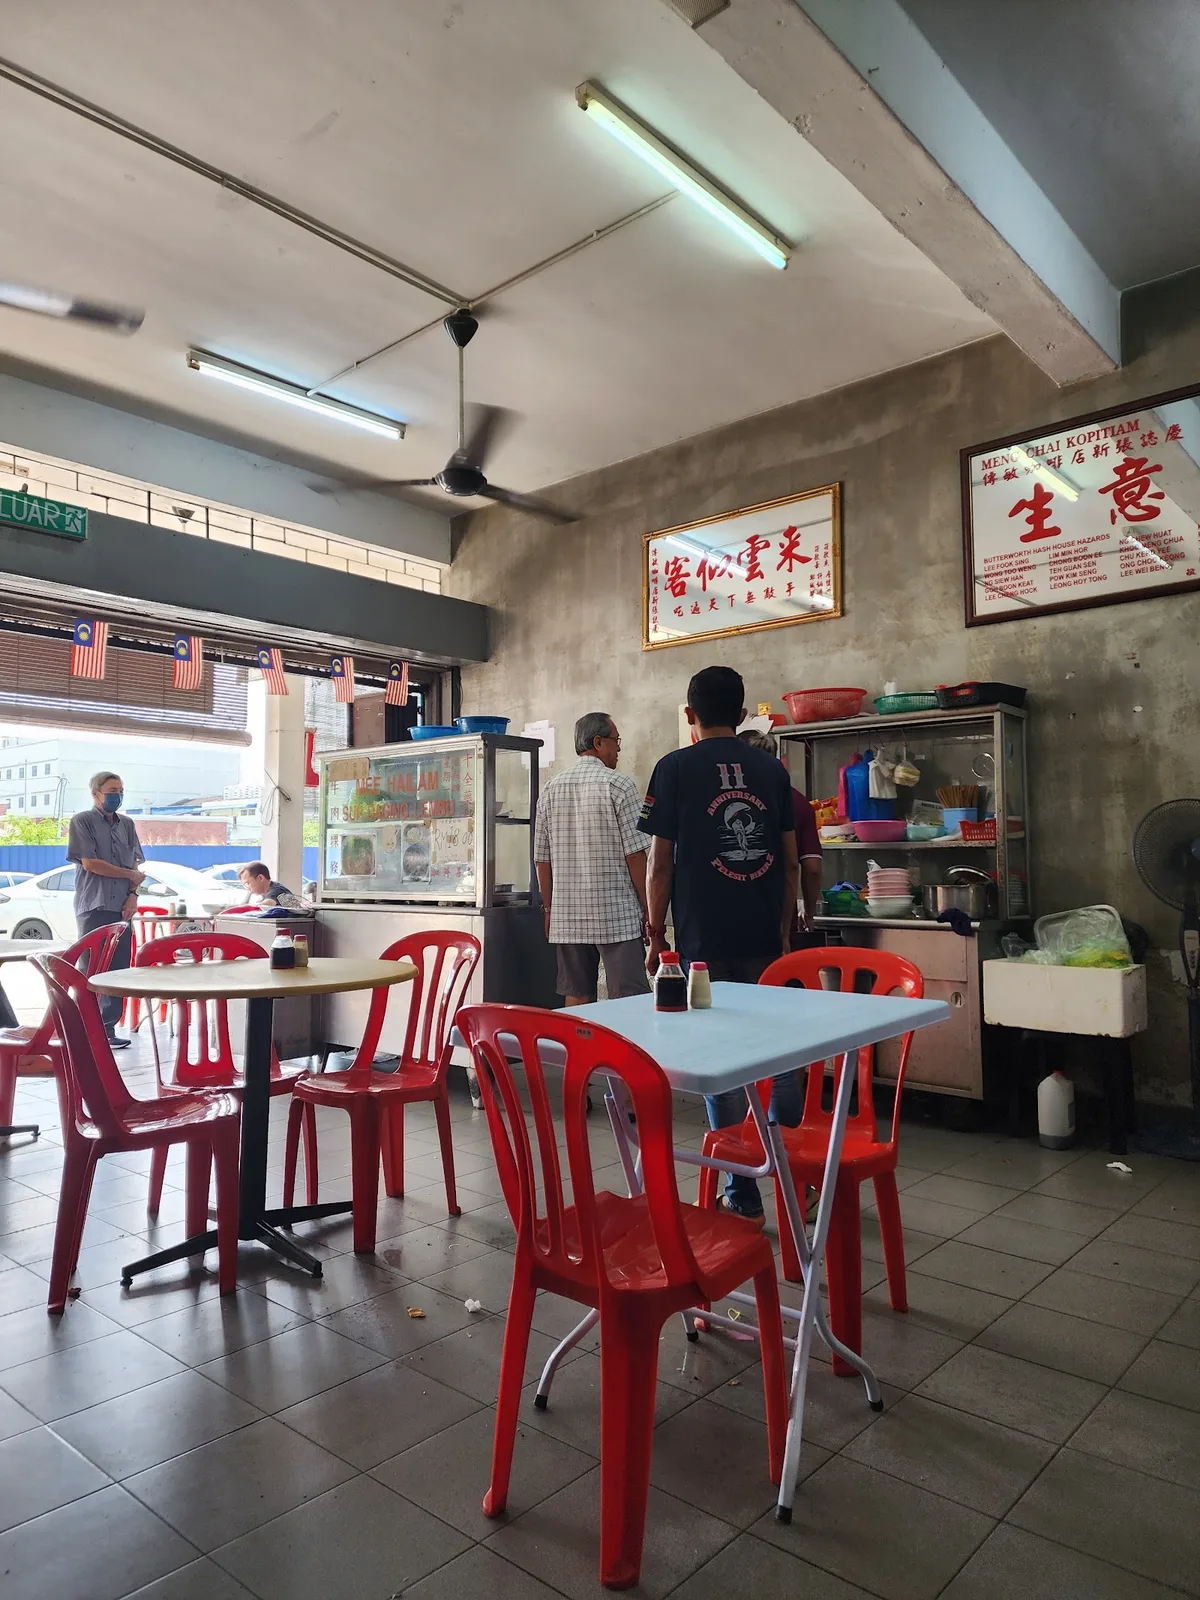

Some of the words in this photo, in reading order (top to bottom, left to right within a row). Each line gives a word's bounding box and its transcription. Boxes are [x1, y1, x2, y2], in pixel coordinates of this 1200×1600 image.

[981, 449, 1020, 471] MENG
[1025, 439, 1060, 459] CHAI
[1066, 418, 1140, 449] KOPITIAM
[1008, 456, 1165, 543] 生意
[1152, 530, 1172, 538] HUAT
[1164, 536, 1185, 544] CHUA
[983, 549, 1032, 564] BUTTERWORTH
[1032, 545, 1051, 555] HASH
[1052, 540, 1076, 550] HOUSE
[1077, 533, 1111, 545] HAZARDS
[1060, 550, 1073, 558] MIN
[1074, 546, 1088, 554] HOR
[996, 560, 1014, 569] FOOK
[1048, 558, 1072, 566] CHONG
[1073, 552, 1092, 562] BOON
[1120, 554, 1134, 562] CHU
[984, 571, 1003, 579] WONG
[1018, 564, 1037, 572] WENG
[1062, 564, 1082, 572] GUAN
[1120, 562, 1136, 570] ONG
[1135, 566, 1148, 574] WEI
[994, 576, 1010, 584] SIEW
[1049, 574, 1064, 582] POW
[1066, 572, 1078, 580] KIM
[1078, 568, 1098, 576] SENG
[1050, 581, 1072, 590] LEONG
[1088, 574, 1108, 582] TONG
[1018, 580, 1034, 588] KEAT
[1020, 586, 1038, 595] HOCK
[356, 775, 381, 796] MEE
[386, 770, 439, 793] HAILAM
[716, 763, 747, 790] 11
[414, 799, 456, 818] LEMBU
[706, 790, 768, 817] ANNIVERSARY
[710, 856, 747, 882] PELESIT
